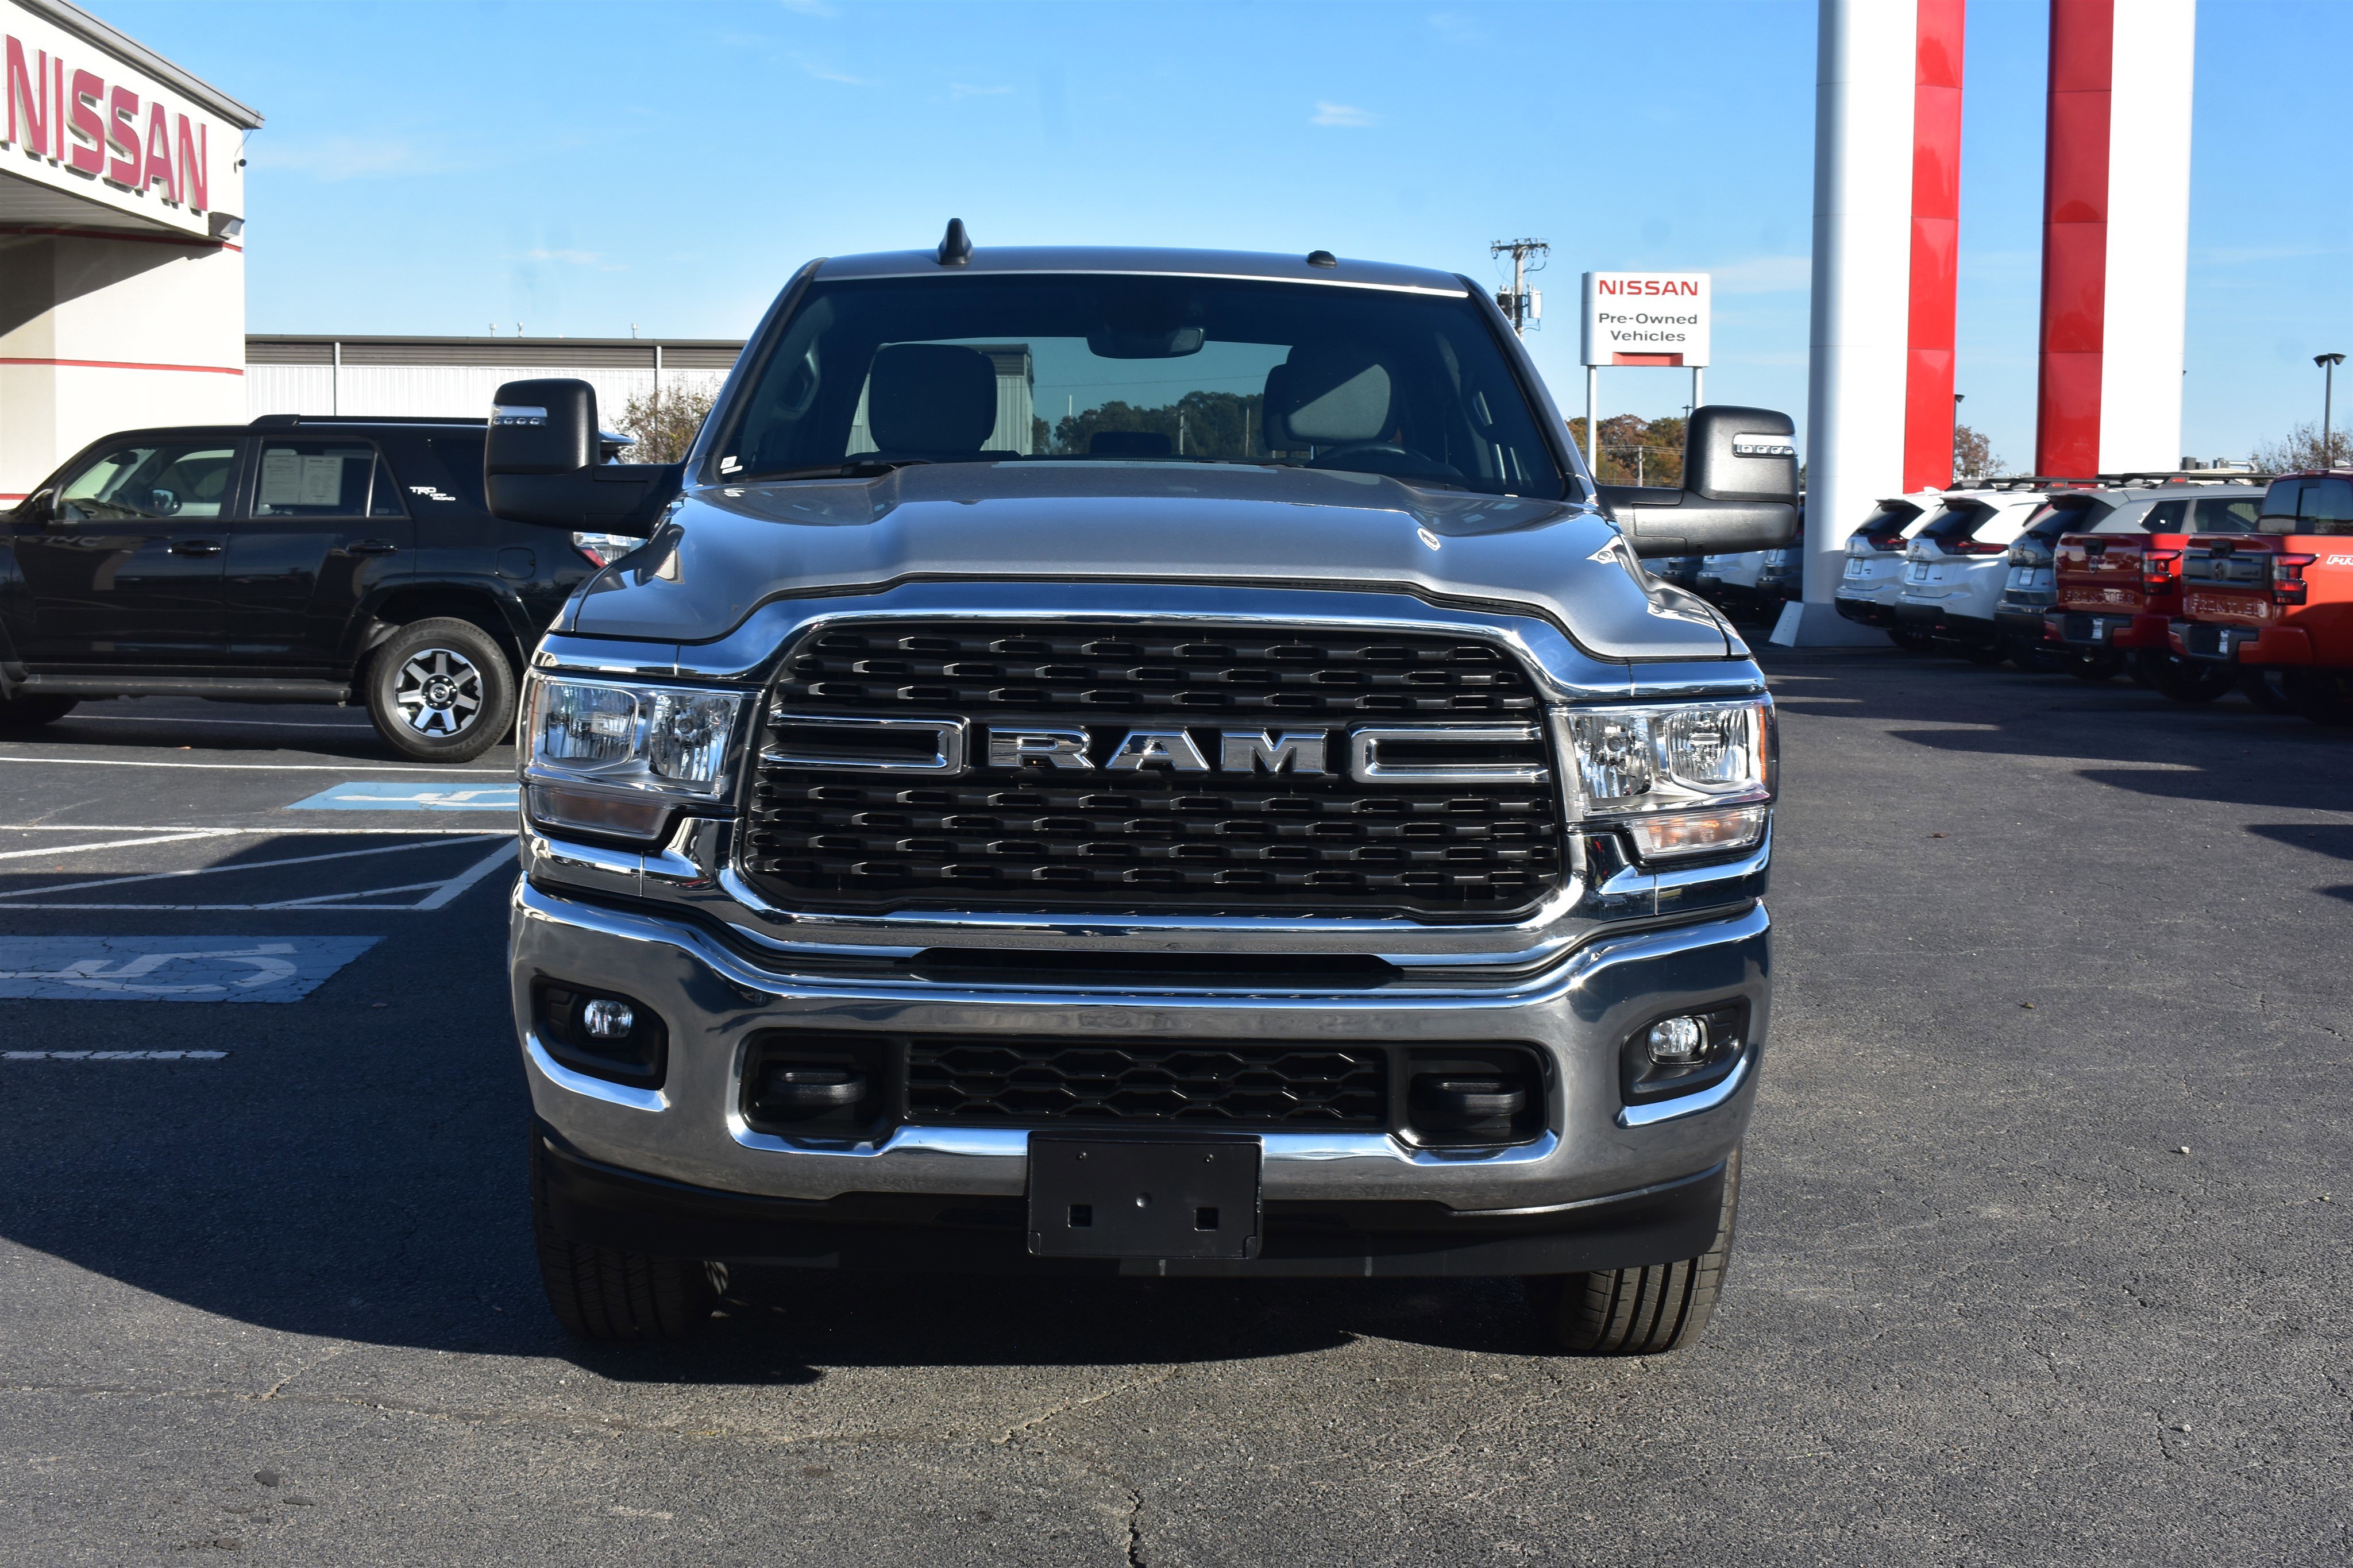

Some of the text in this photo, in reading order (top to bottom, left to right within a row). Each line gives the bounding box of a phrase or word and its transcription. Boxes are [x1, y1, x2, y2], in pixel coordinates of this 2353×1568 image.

[2, 34, 207, 211] NISSAN
[1599, 280, 1698, 295] NISSAN
[1599, 313, 1697, 324] Pre-Owned
[1610, 330, 1685, 341] Vehicles
[409, 486, 437, 495] TRD
[2065, 590, 2135, 604] FRONTIER
[988, 727, 1328, 773] RAM
